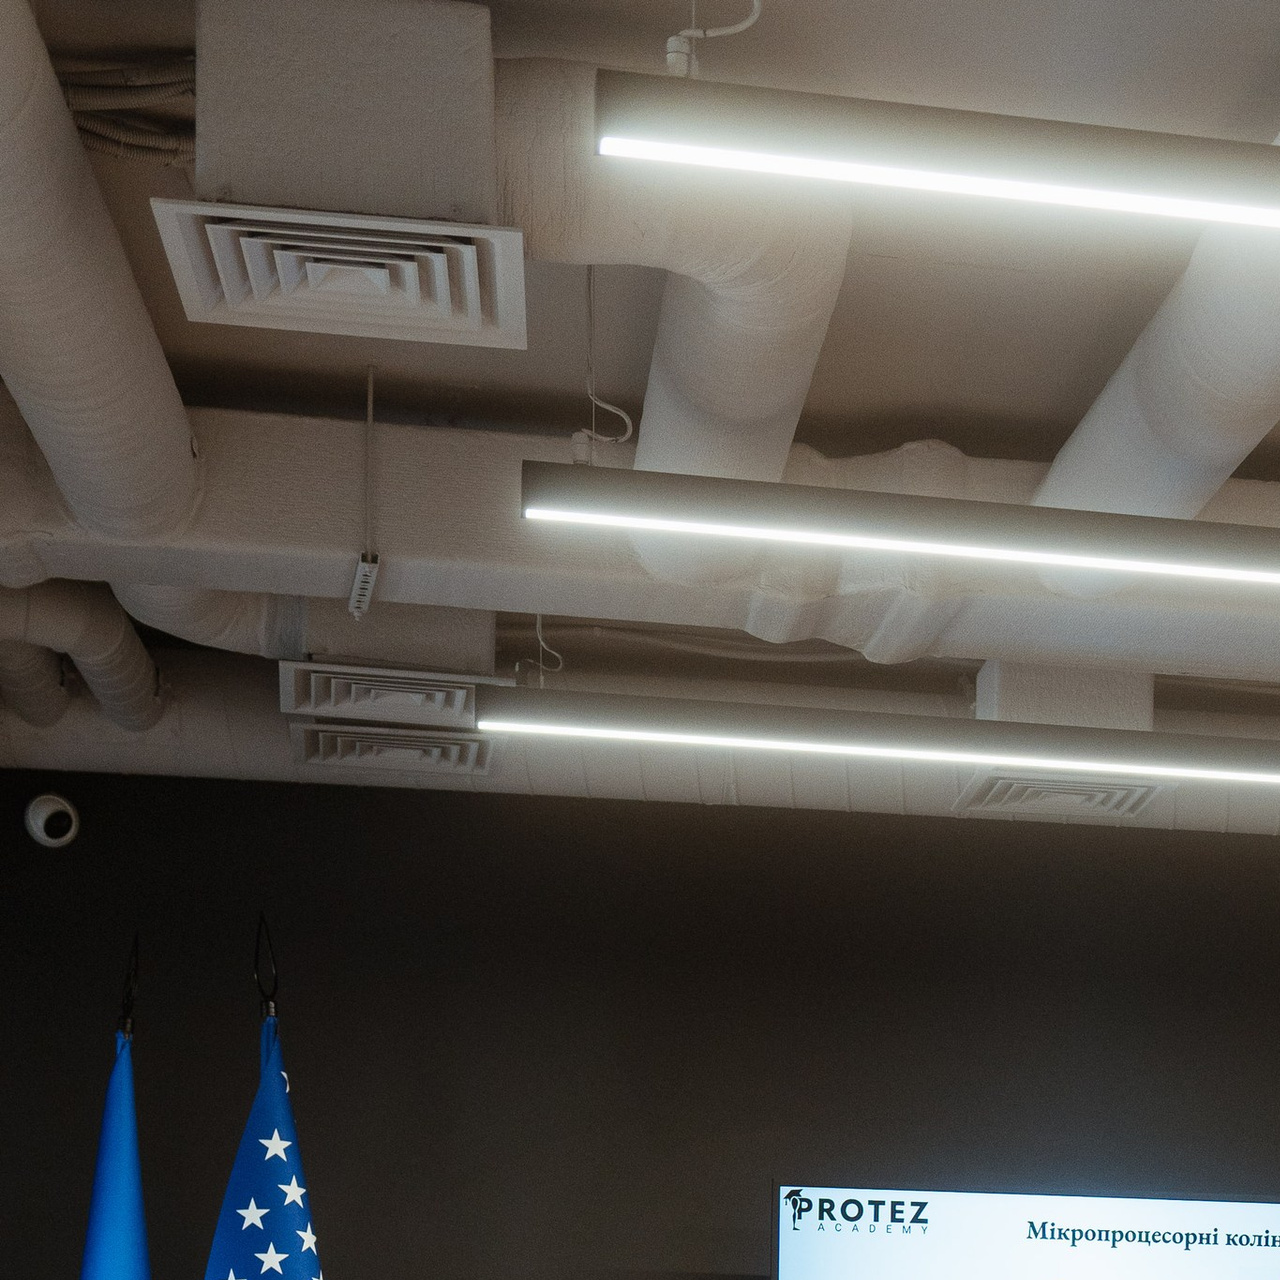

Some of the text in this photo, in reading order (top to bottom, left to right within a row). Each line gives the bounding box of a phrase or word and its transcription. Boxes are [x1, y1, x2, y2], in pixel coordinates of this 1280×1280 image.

[797, 1197, 929, 1224] PROTEZ
[817, 1222, 929, 1234] ACADEMY
[1026, 1220, 1219, 1251] Мікропроцесорні
